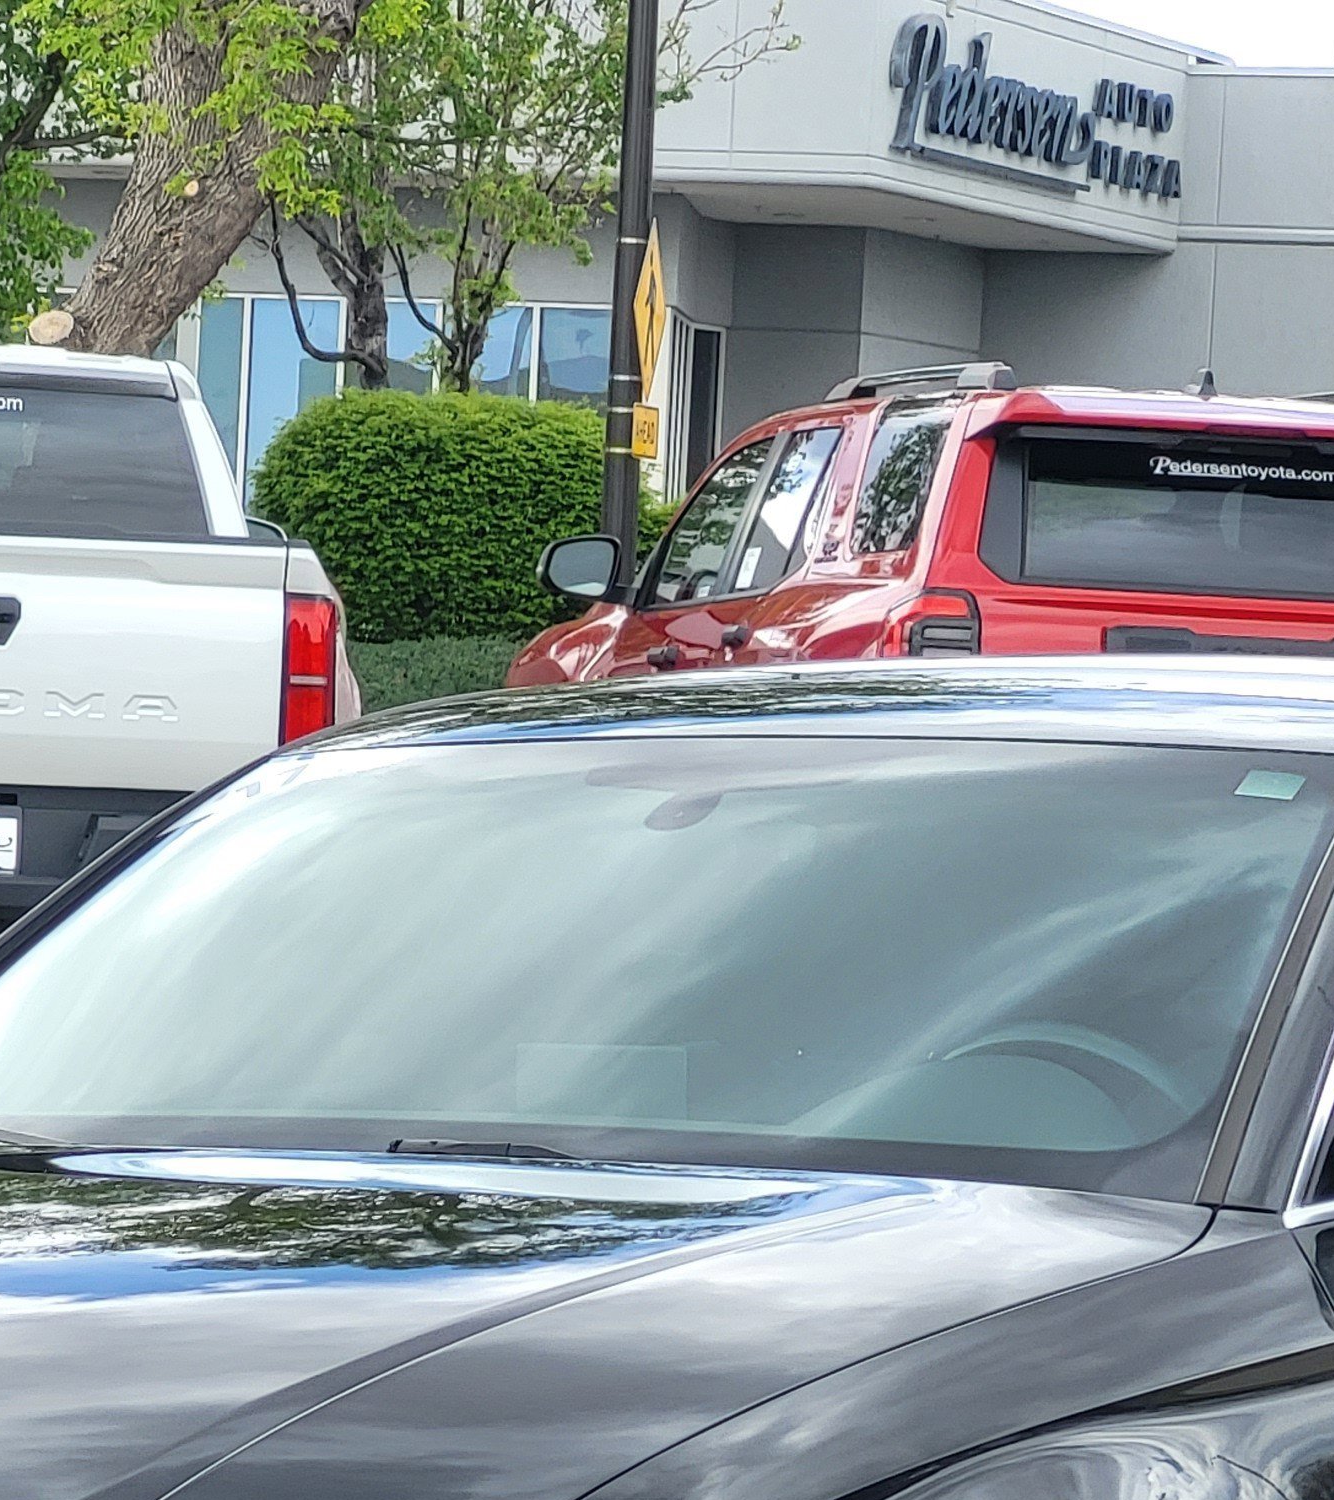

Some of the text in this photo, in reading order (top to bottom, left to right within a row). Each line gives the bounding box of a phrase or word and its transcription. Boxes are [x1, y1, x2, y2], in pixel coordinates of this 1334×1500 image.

[889, 13, 1095, 166] Pedersen
[1093, 78, 1174, 132] AUTO
[1087, 140, 1181, 198] PLAZA
